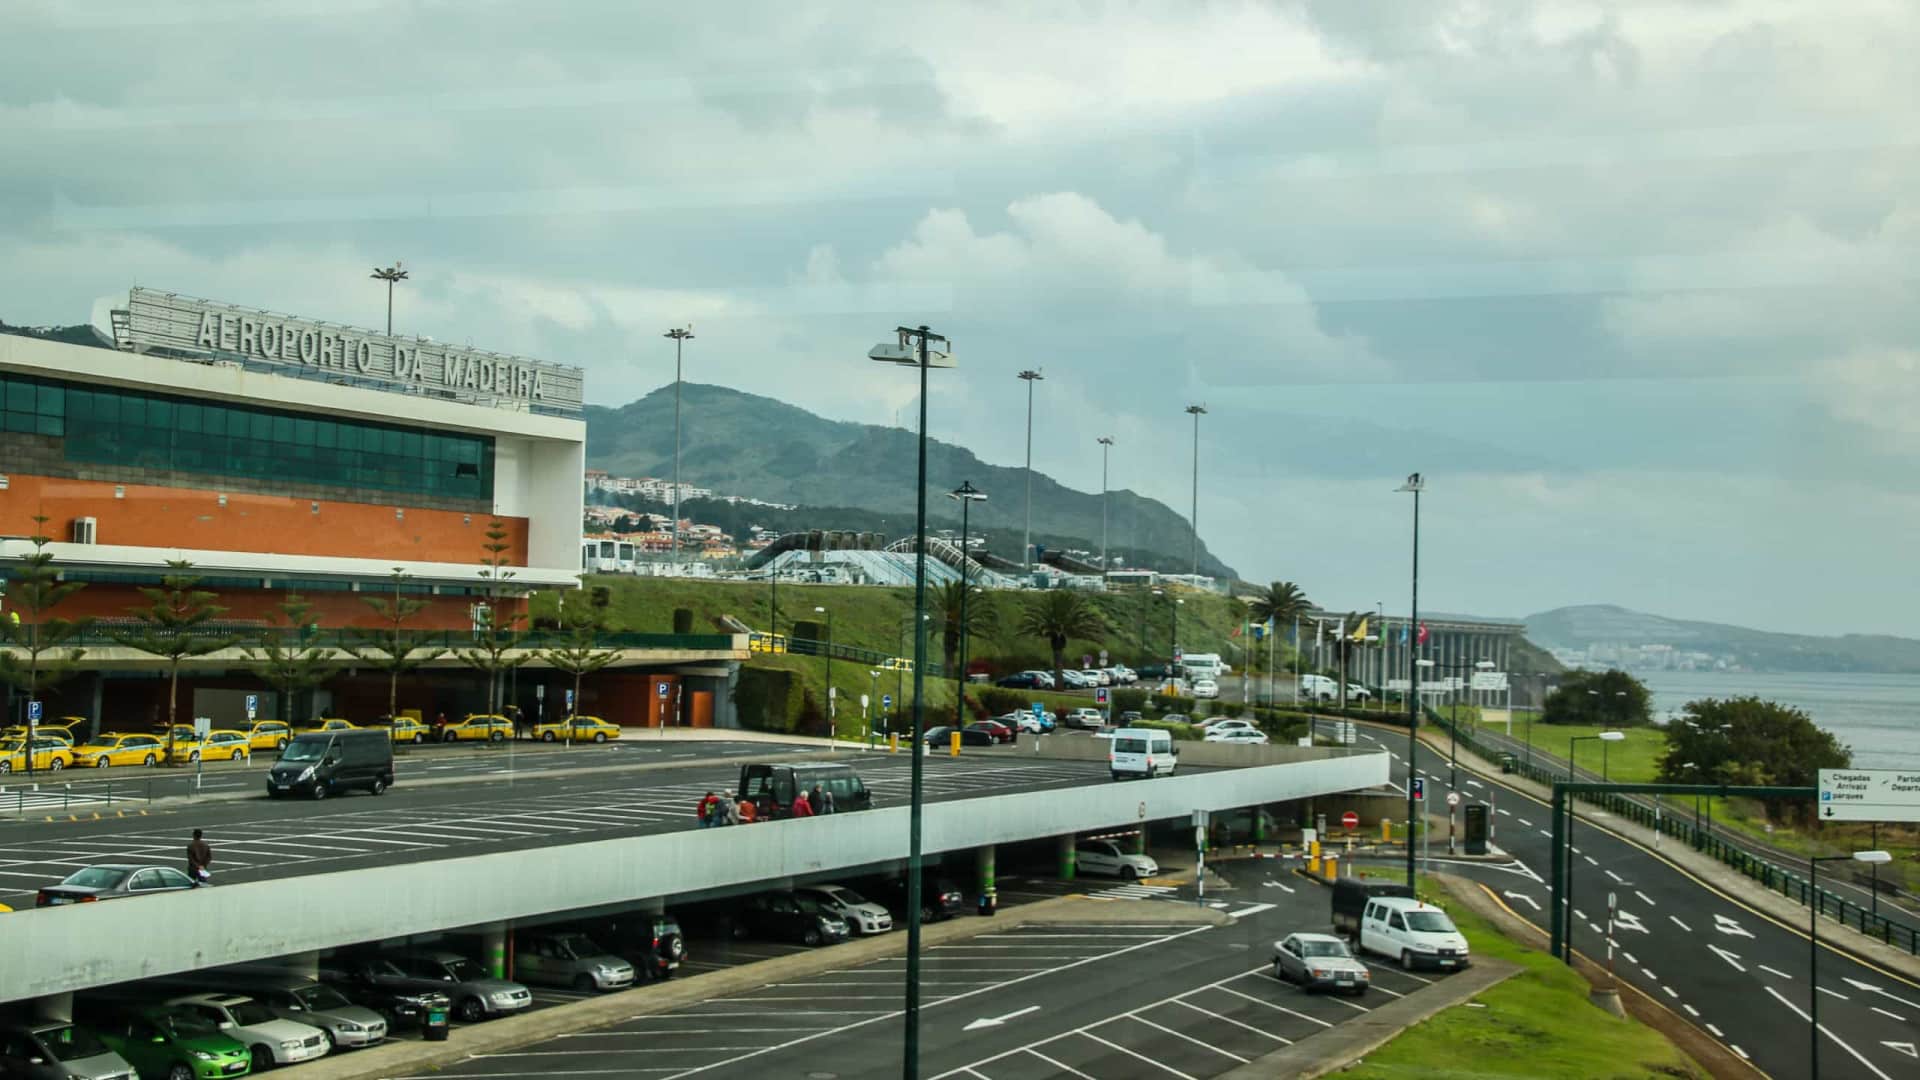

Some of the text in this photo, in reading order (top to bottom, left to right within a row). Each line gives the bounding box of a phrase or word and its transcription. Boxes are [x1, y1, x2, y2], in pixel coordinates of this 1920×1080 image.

[198, 311, 544, 399] AEROPORTO DA MADEIRA
[1832, 773, 1871, 782] Chegadas
